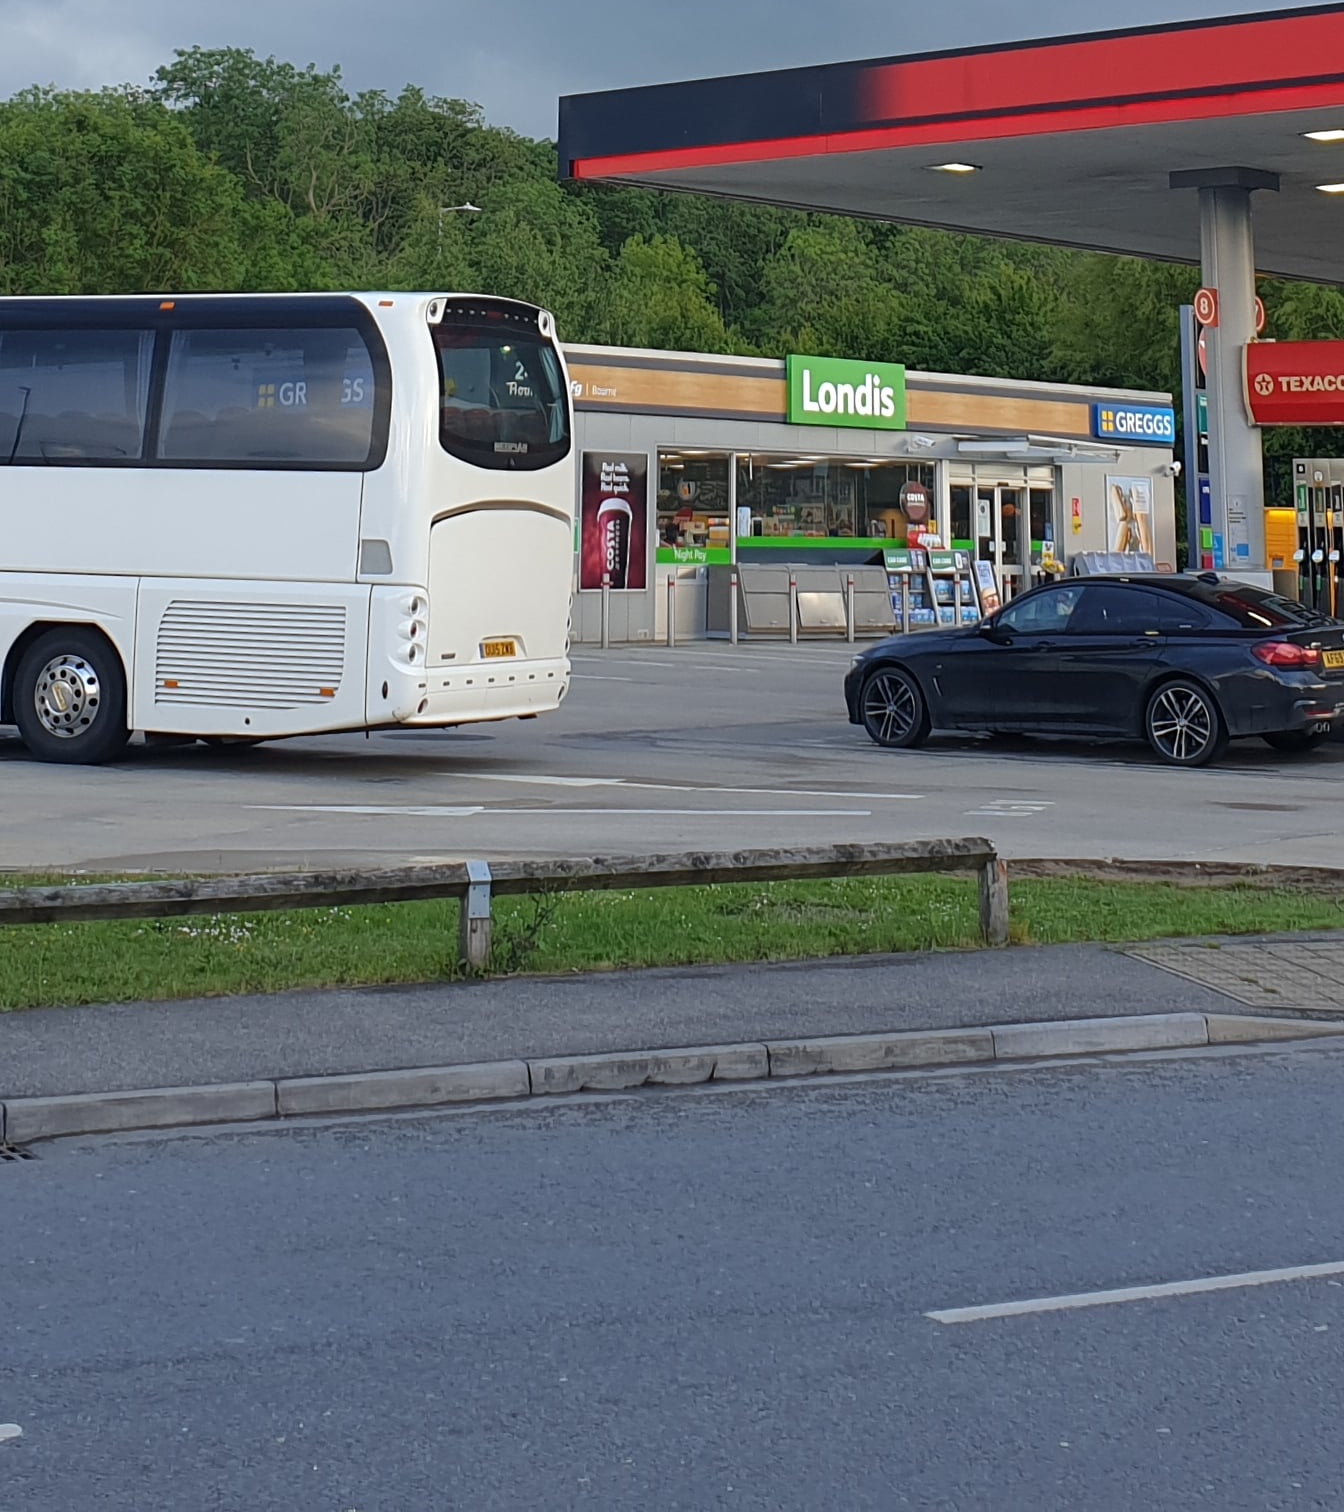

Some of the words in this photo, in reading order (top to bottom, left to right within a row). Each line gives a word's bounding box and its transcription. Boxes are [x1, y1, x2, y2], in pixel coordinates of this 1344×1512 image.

[802, 369, 895, 418] Londis
[1115, 411, 1172, 435] GREGGS
[607, 519, 616, 571] COSTA
[673, 544, 693, 562] Night
